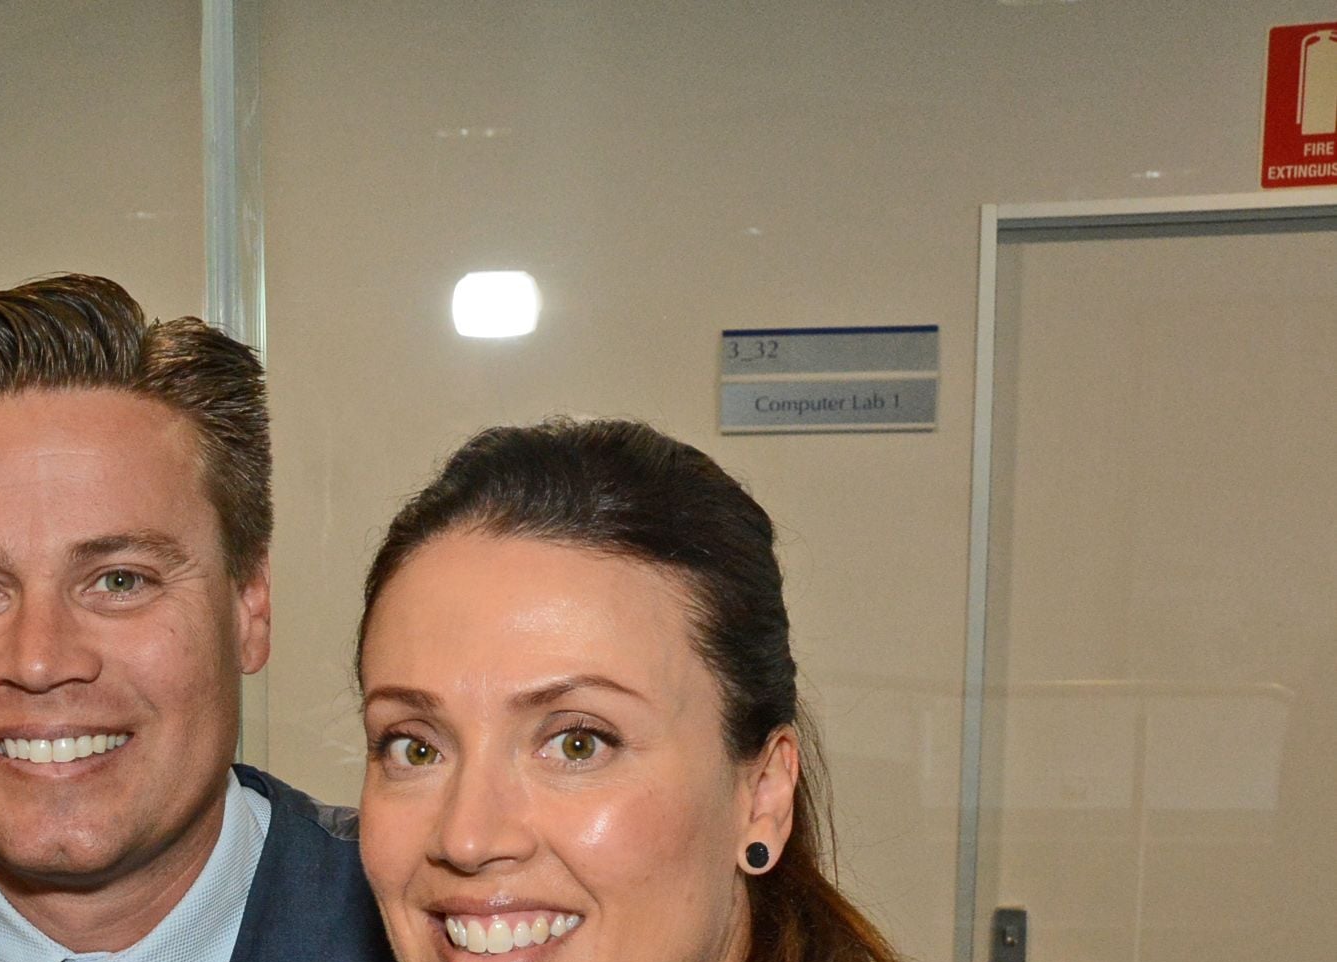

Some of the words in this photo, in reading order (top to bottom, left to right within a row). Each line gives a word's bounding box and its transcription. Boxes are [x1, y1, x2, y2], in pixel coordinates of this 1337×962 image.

[1304, 141, 1334, 156] FIRE
[754, 397, 844, 415] Computer
[852, 393, 885, 411] Lab
[893, 394, 900, 408] 1
